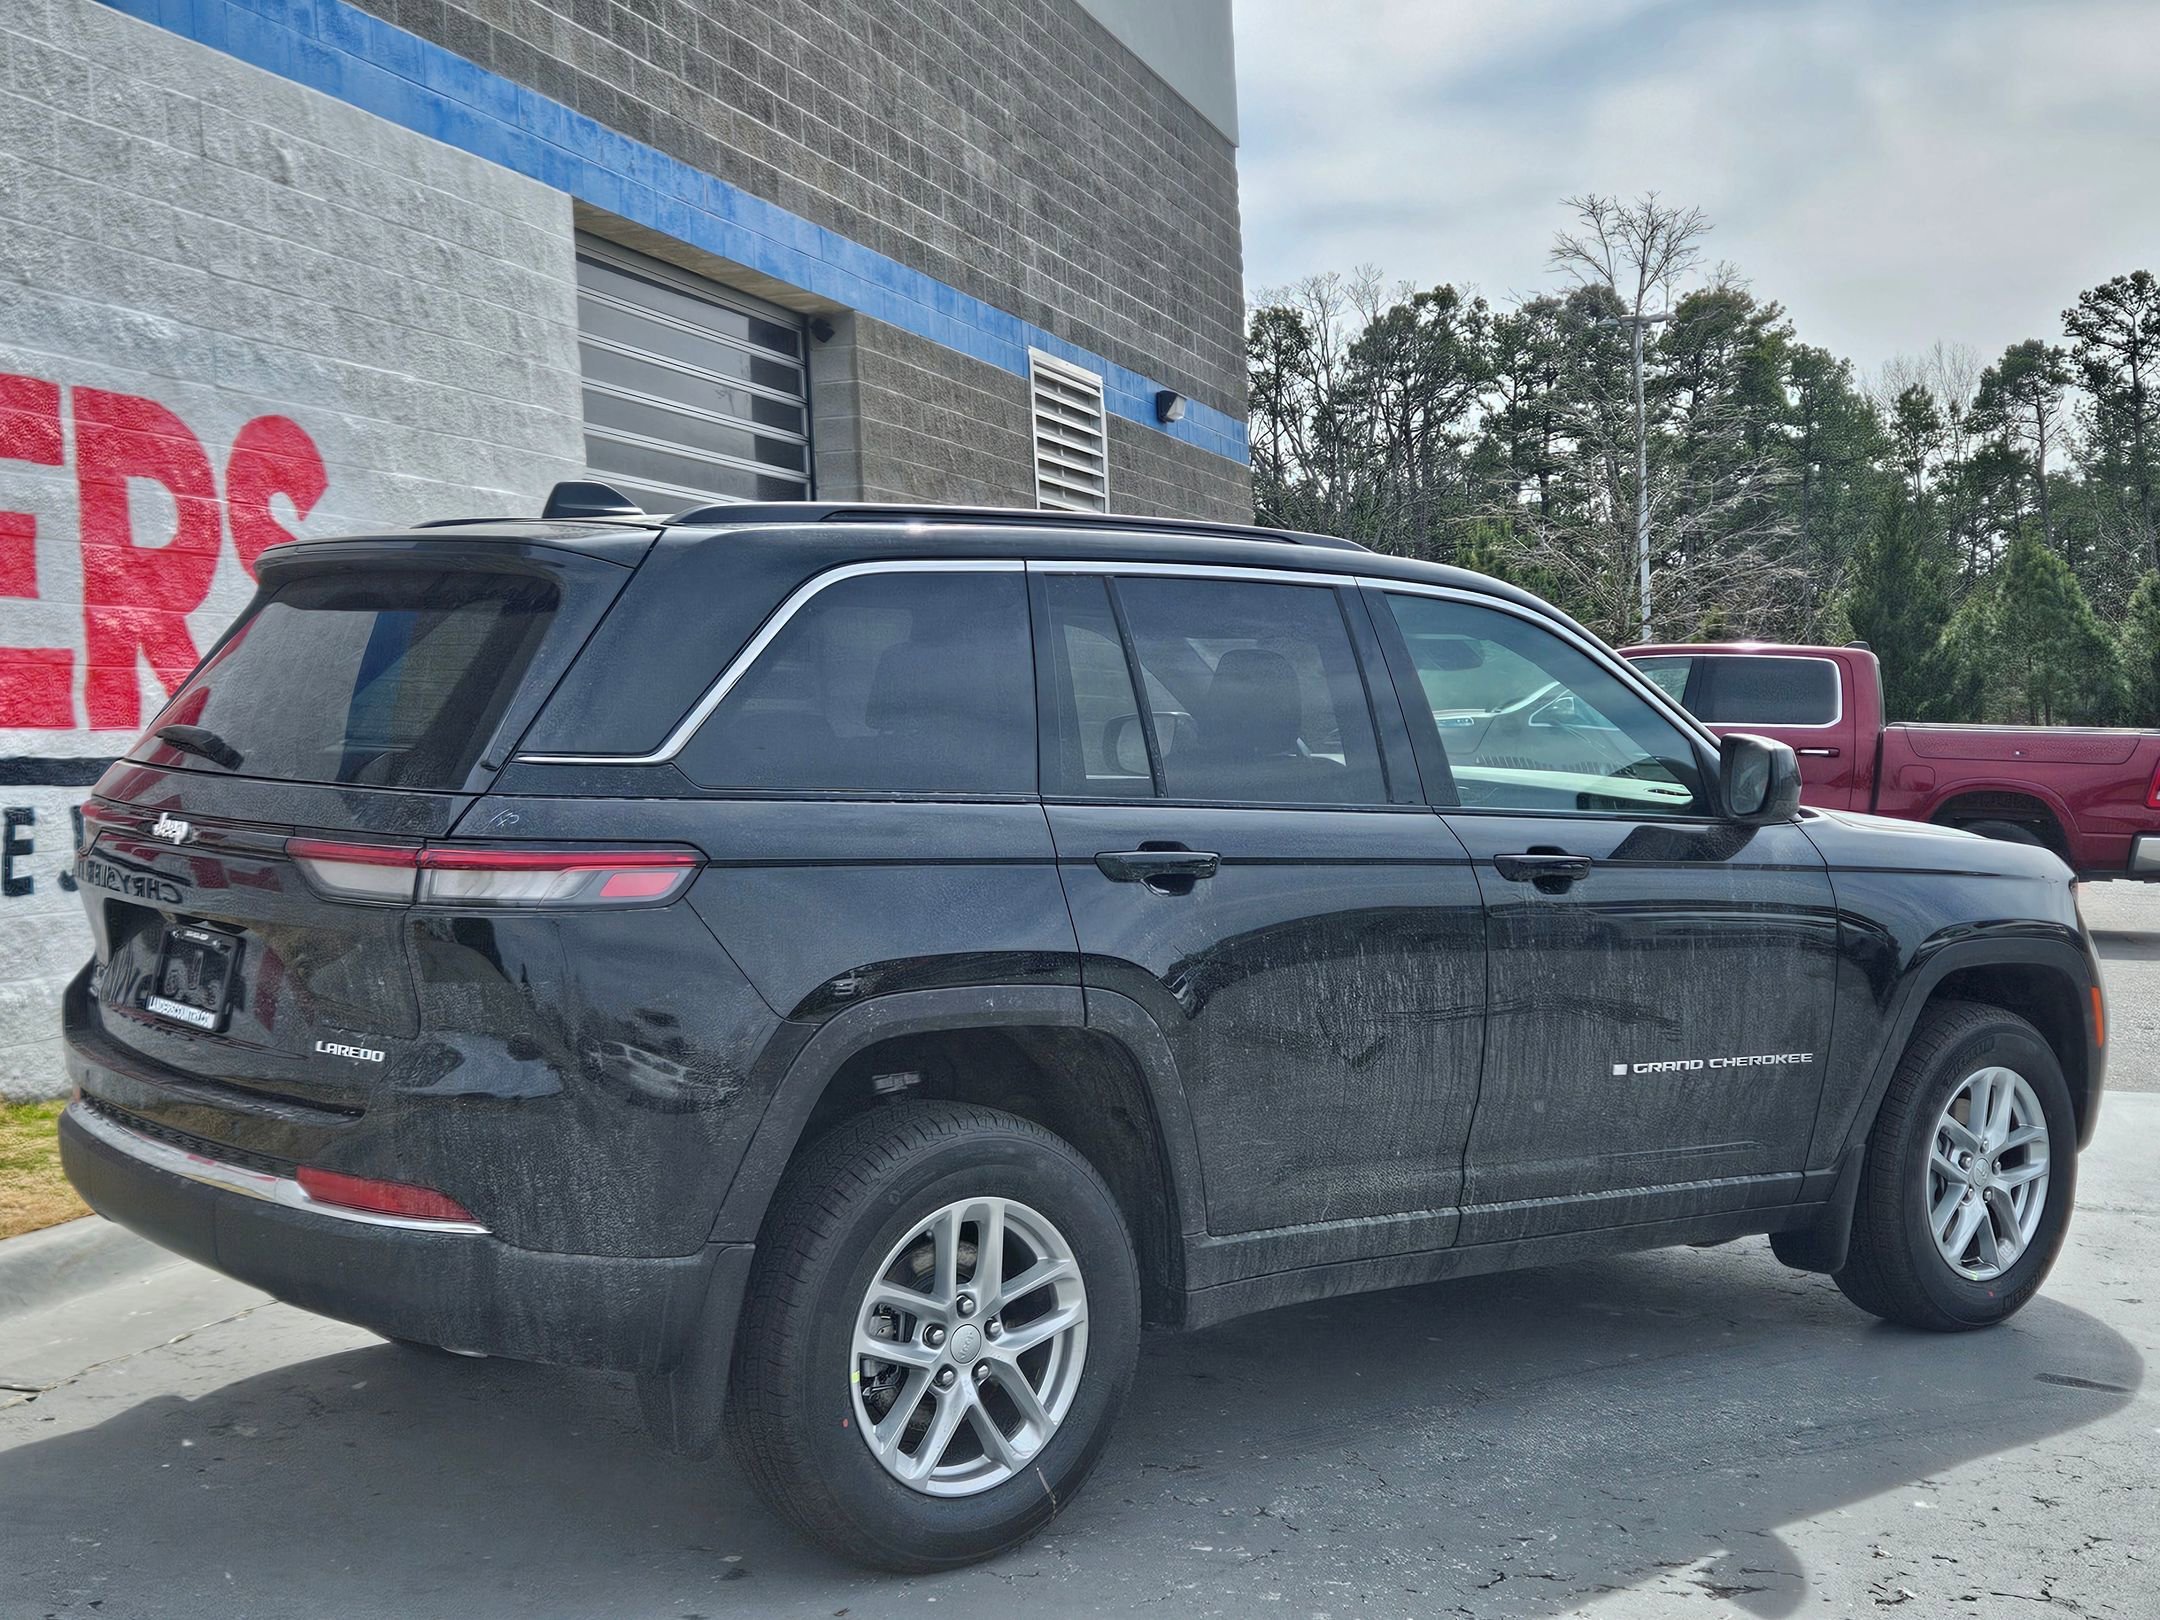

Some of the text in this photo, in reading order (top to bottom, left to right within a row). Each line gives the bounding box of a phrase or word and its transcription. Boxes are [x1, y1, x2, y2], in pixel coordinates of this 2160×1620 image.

[152, 812, 188, 844] Jeep
[316, 1040, 385, 1062] LAREDO
[1633, 1053, 1813, 1074] GRAND CHEROKEE
